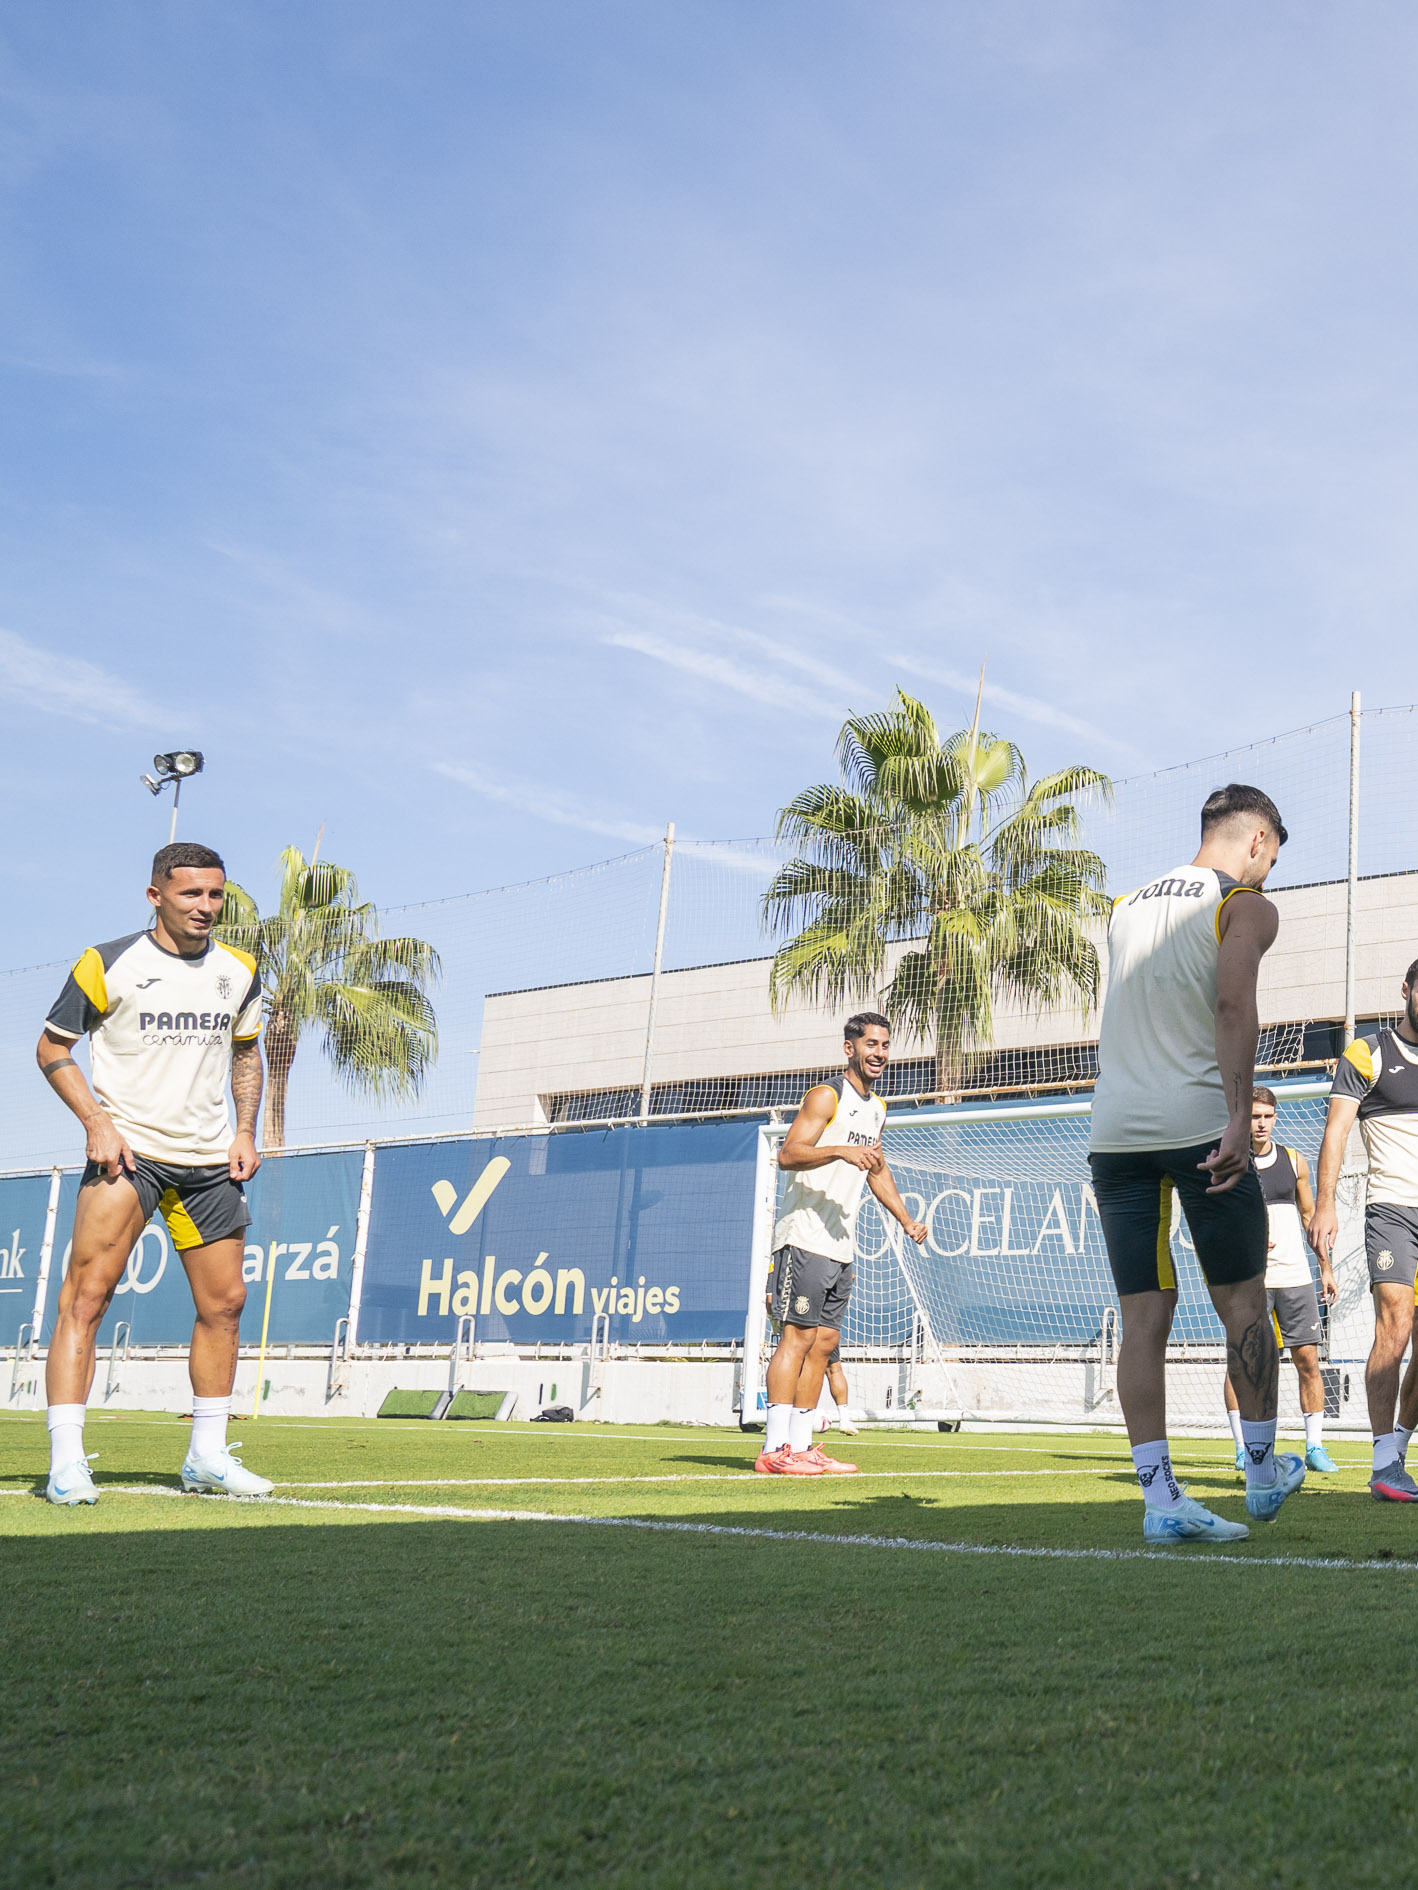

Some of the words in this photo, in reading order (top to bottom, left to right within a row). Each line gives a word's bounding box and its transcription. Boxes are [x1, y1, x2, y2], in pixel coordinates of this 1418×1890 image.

[139, 1011, 231, 1031] PAMESA
[853, 1184, 1100, 1260] ORCELAN
[242, 1225, 340, 1284] arzá
[417, 1251, 586, 1317] Halcón
[590, 1275, 681, 1323] viajes
[1161, 1455, 1174, 1482] SOCKS
[1167, 1481, 1182, 1502] NEO
